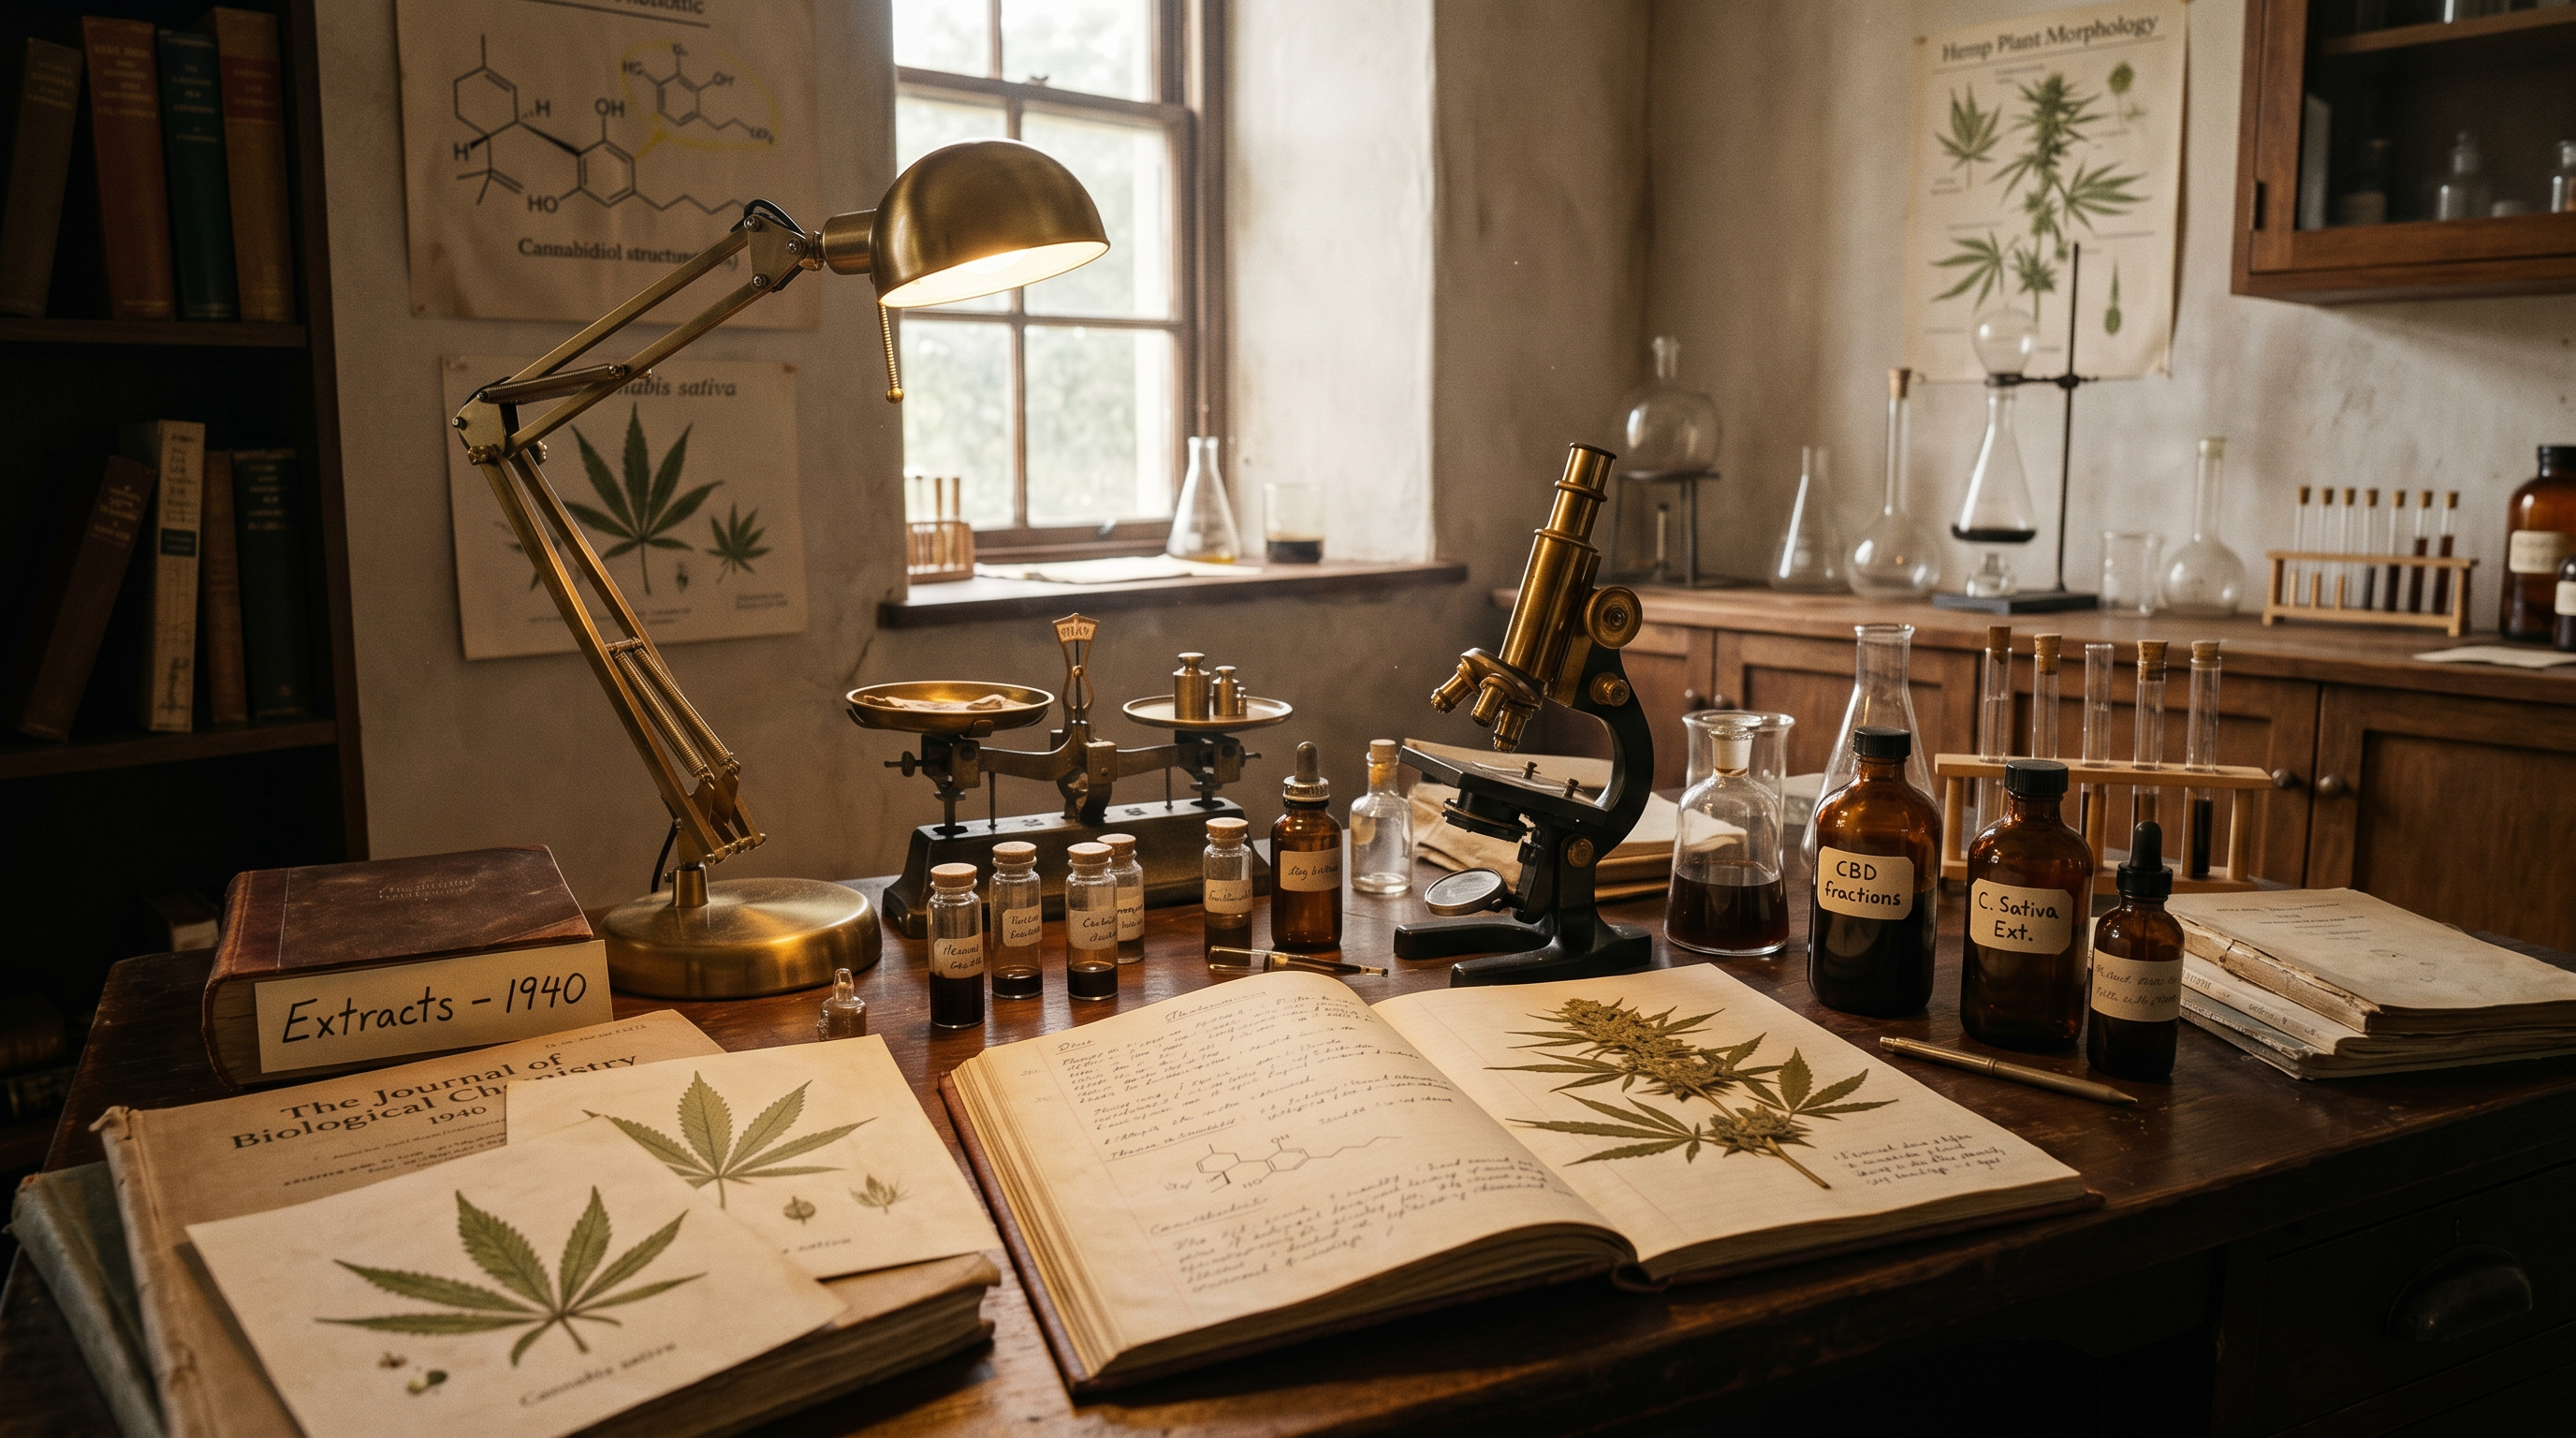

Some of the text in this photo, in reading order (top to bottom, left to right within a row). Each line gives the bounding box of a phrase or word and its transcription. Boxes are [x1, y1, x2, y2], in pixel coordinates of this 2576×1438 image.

[1942, 15, 2159, 63] Hemp Plant Morphology
[536, 100, 550, 117] H
[595, 98, 624, 117] OH
[454, 143, 468, 160] H
[528, 197, 558, 214] HO
[518, 237, 622, 261] Cannabidiol
[679, 376, 737, 397] sativa
[1836, 860, 1878, 882] CBD
[1824, 881, 1901, 907] fractions
[1978, 891, 2059, 919] C. Sativa
[1994, 920, 2034, 943] Ext.
[282, 986, 454, 1044] Extracts
[505, 972, 588, 1014] 1940
[280, 1052, 564, 1120] The Journal of
[230, 1055, 637, 1149] Biological Chistry
[428, 1106, 488, 1124] 1940
